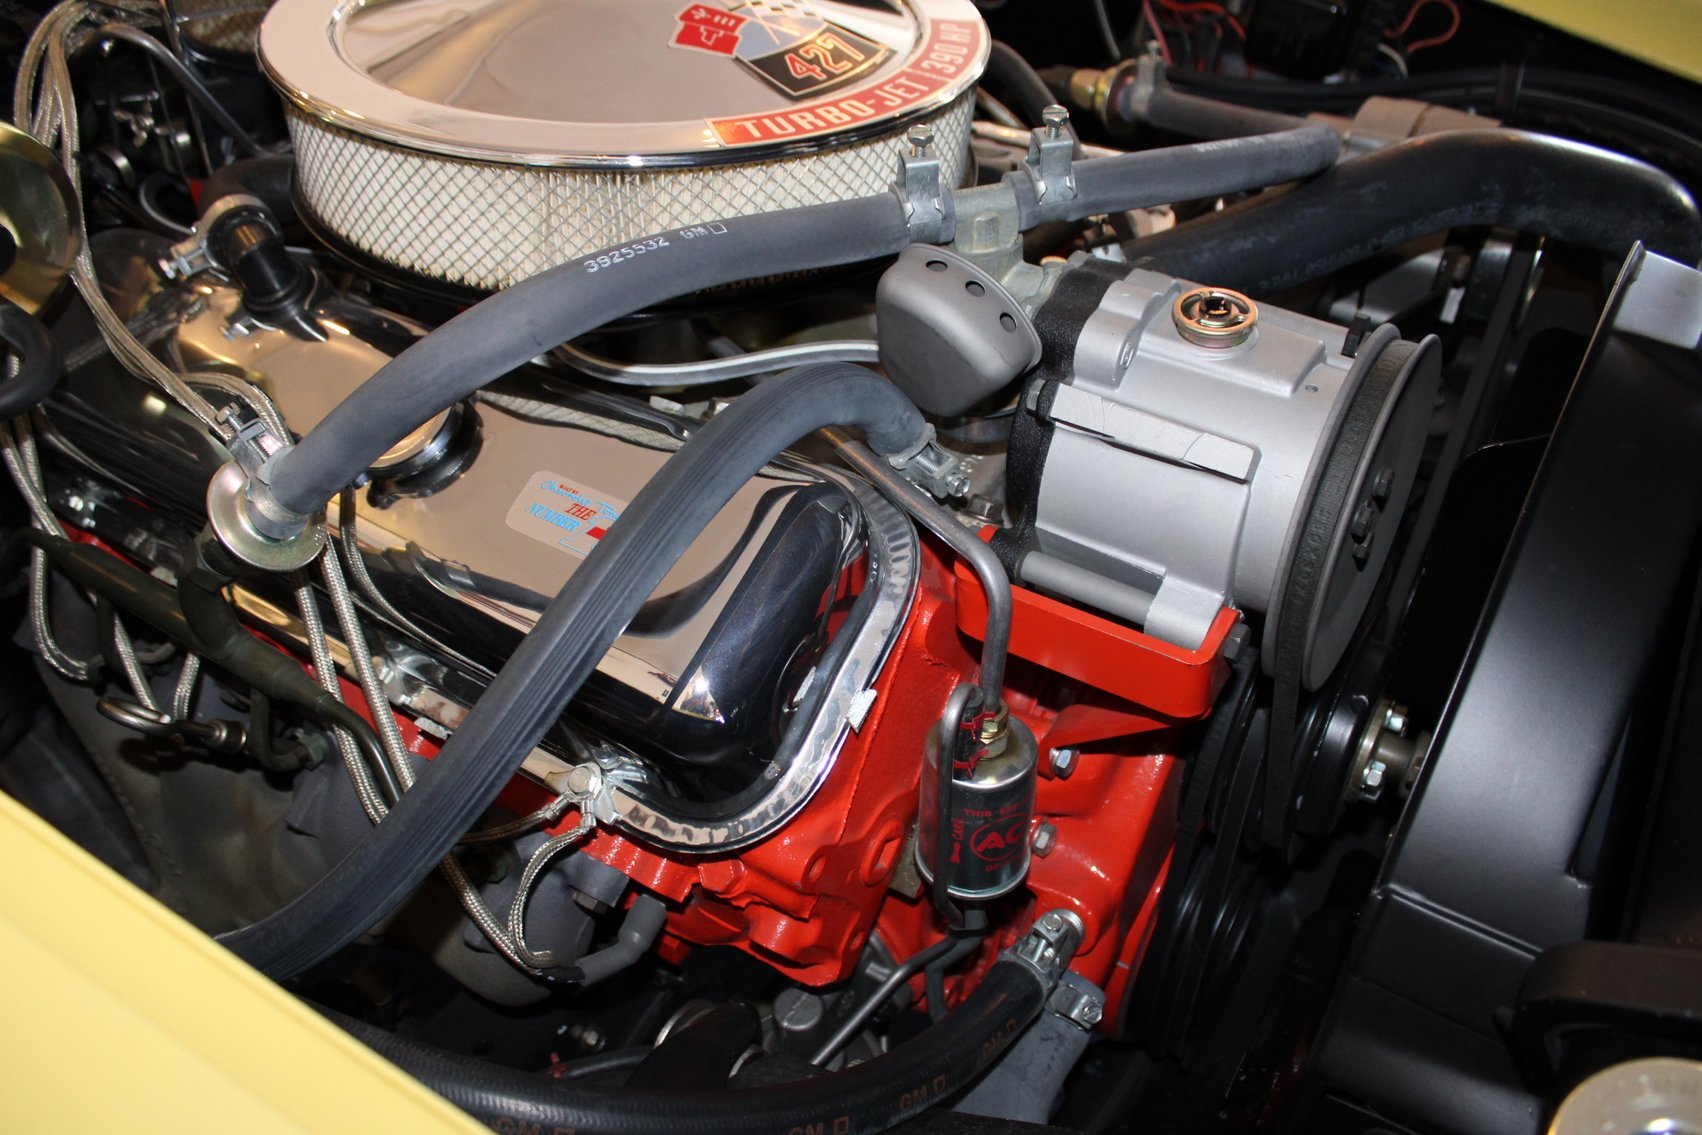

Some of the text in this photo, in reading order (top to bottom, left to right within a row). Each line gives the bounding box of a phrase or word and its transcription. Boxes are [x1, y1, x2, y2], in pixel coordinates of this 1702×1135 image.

[784, 35, 866, 81] 427
[735, 22, 972, 138] TURBO-JET 390 HP
[584, 226, 709, 273] 3925532 GM
[525, 502, 582, 532] NUMBER
[565, 503, 597, 521] THE
[975, 819, 1025, 852] AC
[899, 1083, 929, 1111] GM
